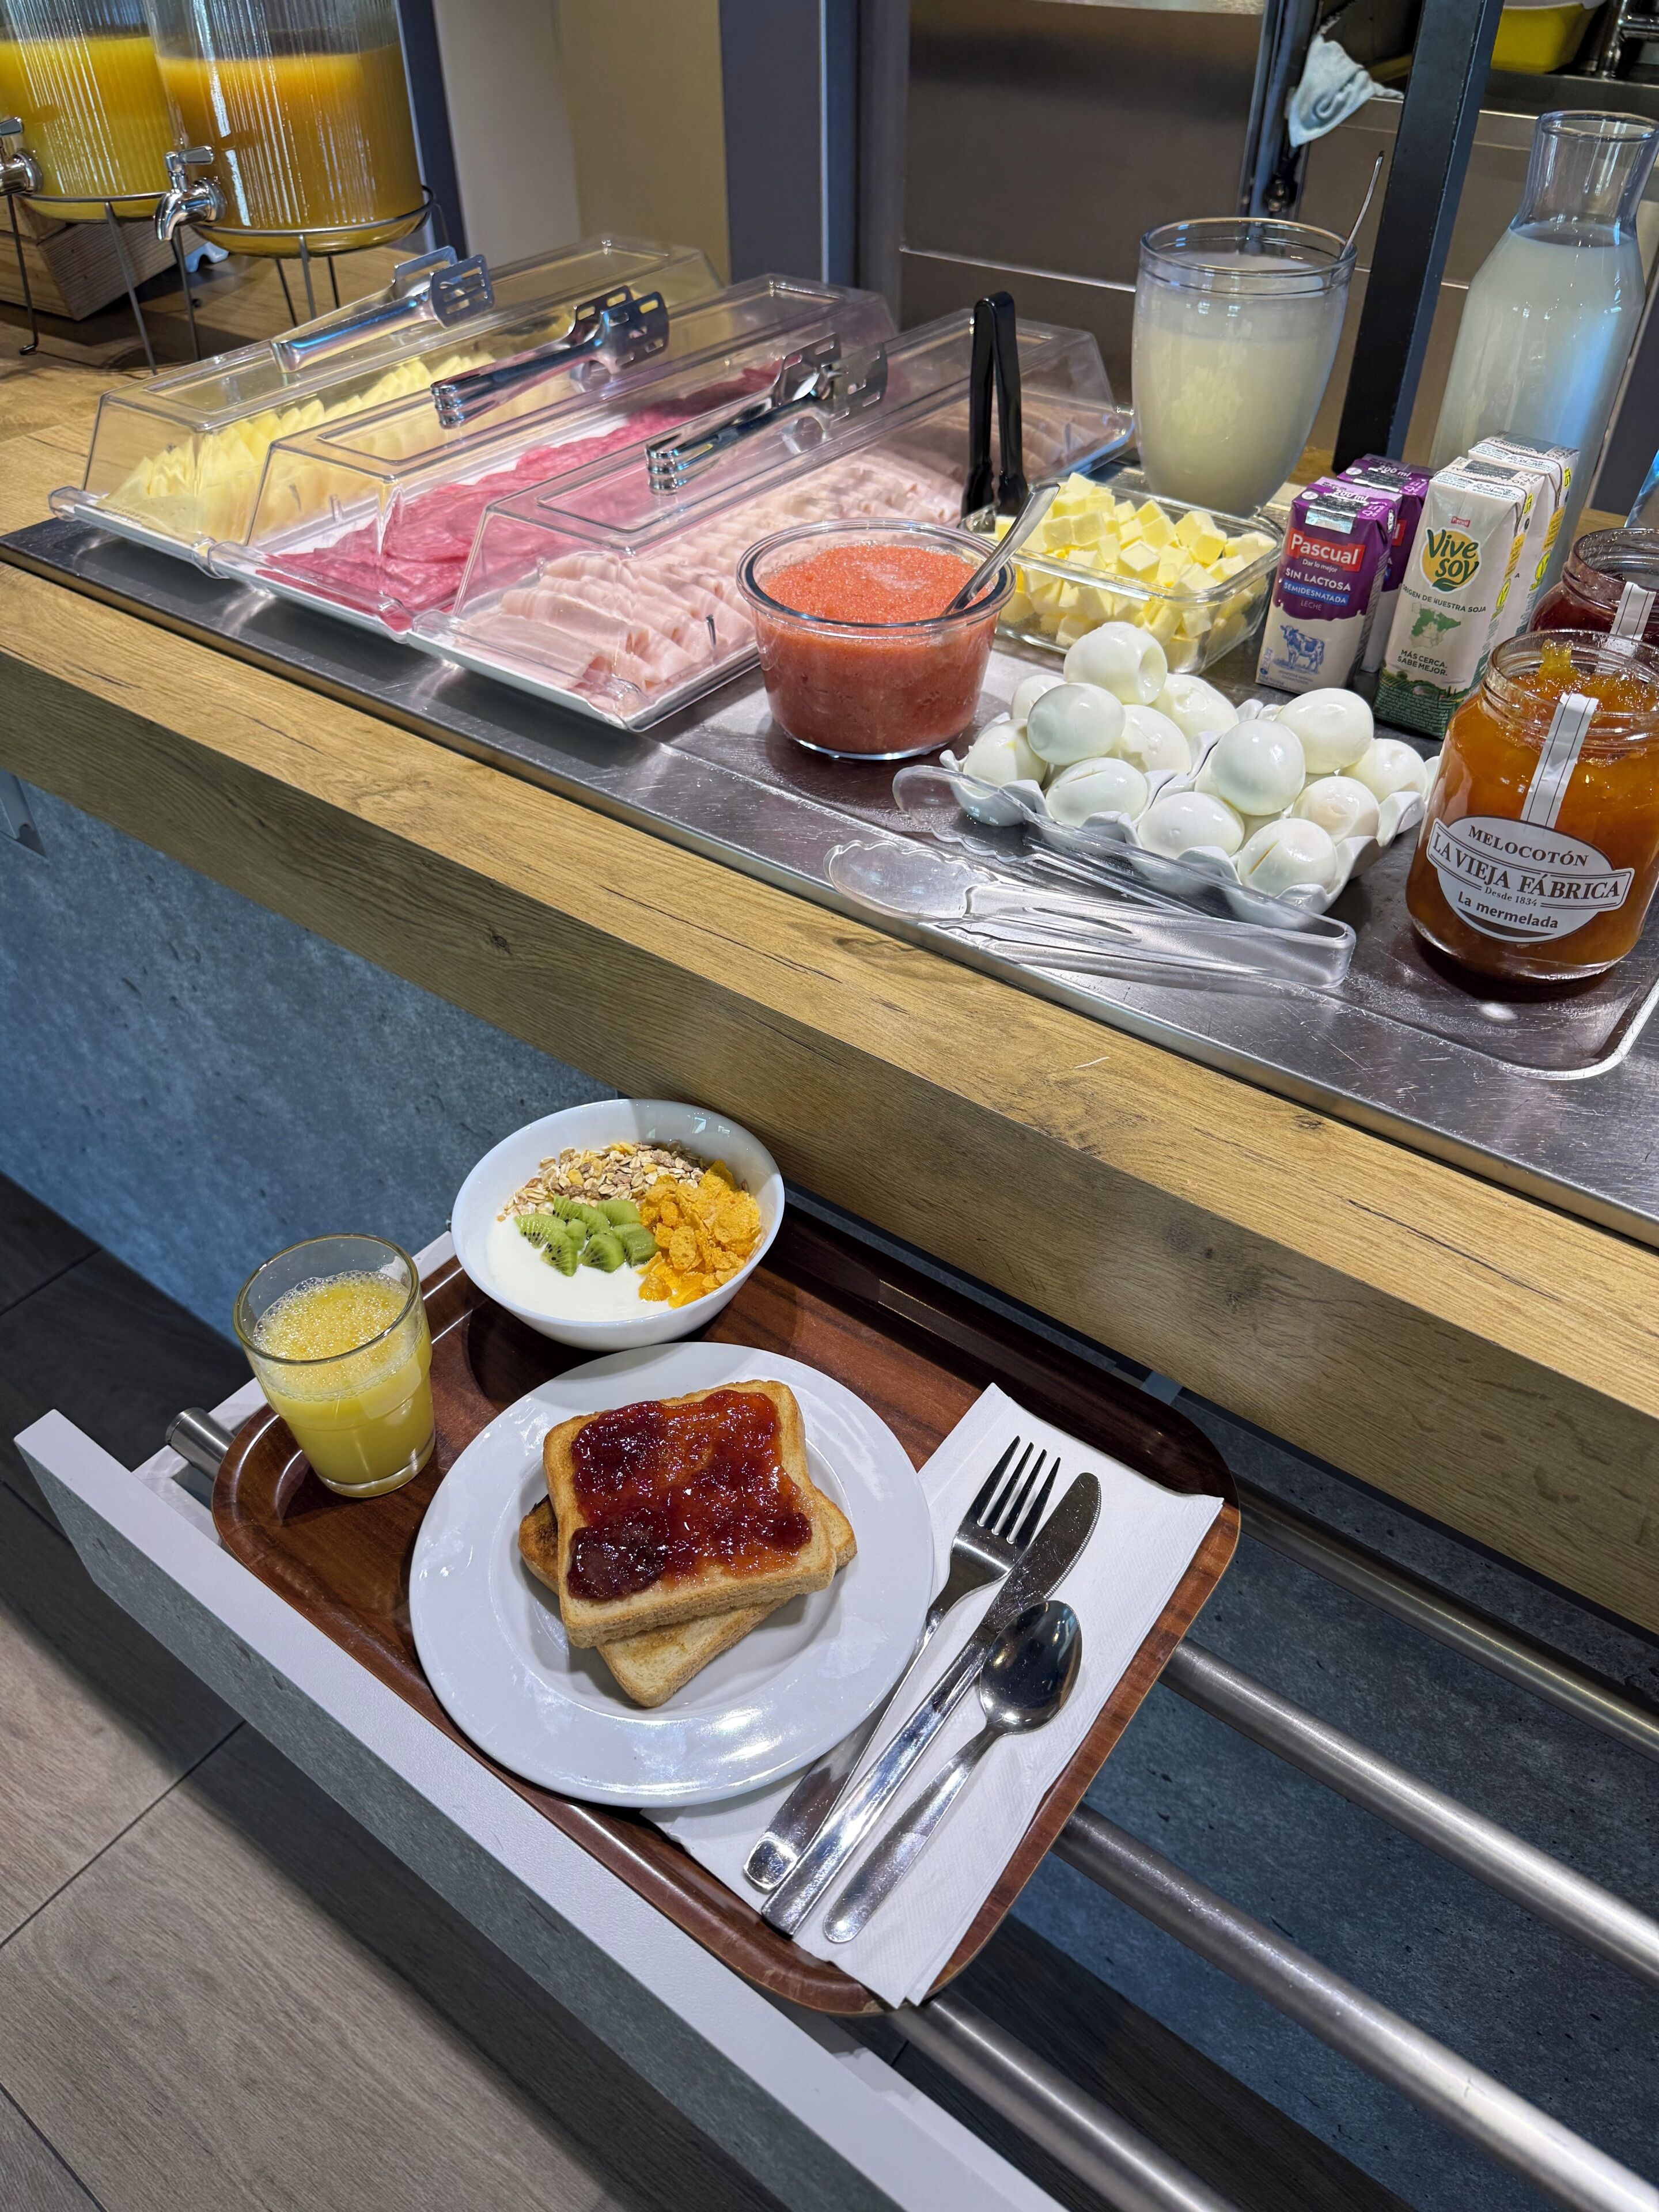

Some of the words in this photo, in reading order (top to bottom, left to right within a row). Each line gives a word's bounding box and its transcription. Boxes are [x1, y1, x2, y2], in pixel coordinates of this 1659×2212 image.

[1378, 465, 1396, 474] 200
[1397, 469, 1412, 478] ml
[1334, 490, 1353, 499] 200
[1354, 494, 1370, 502] ml
[1291, 533, 1359, 565] Pascual
[1427, 529, 1479, 559] Vive
[1302, 558, 1313, 567] Dar
[1320, 563, 1338, 573] mejor
[1434, 558, 1479, 586] soy
[1285, 567, 1302, 580] SIN
[1304, 573, 1351, 592] LACTOSA
[1283, 582, 1347, 604] SEMIDESNATADA
[1422, 595, 1433, 603] DE
[1433, 597, 1466, 612] NUESTRA
[1300, 600, 1322, 611] LECHE
[1397, 656, 1418, 668] SABE
[1418, 663, 1448, 676] MEJOR.
[1400, 649, 1418, 660] MÁS
[1418, 656, 1448, 669] CERCA.
[1468, 825, 1590, 867] MELOCOTÓN
[1432, 832, 1451, 862] LA
[1455, 848, 1510, 889] VIEJA
[1517, 873, 1620, 900] FÁBRICA
[1484, 886, 1513, 902] Desde
[1515, 895, 1538, 907] 1834
[1457, 891, 1472, 907] La
[1476, 902, 1559, 929] mermelada
